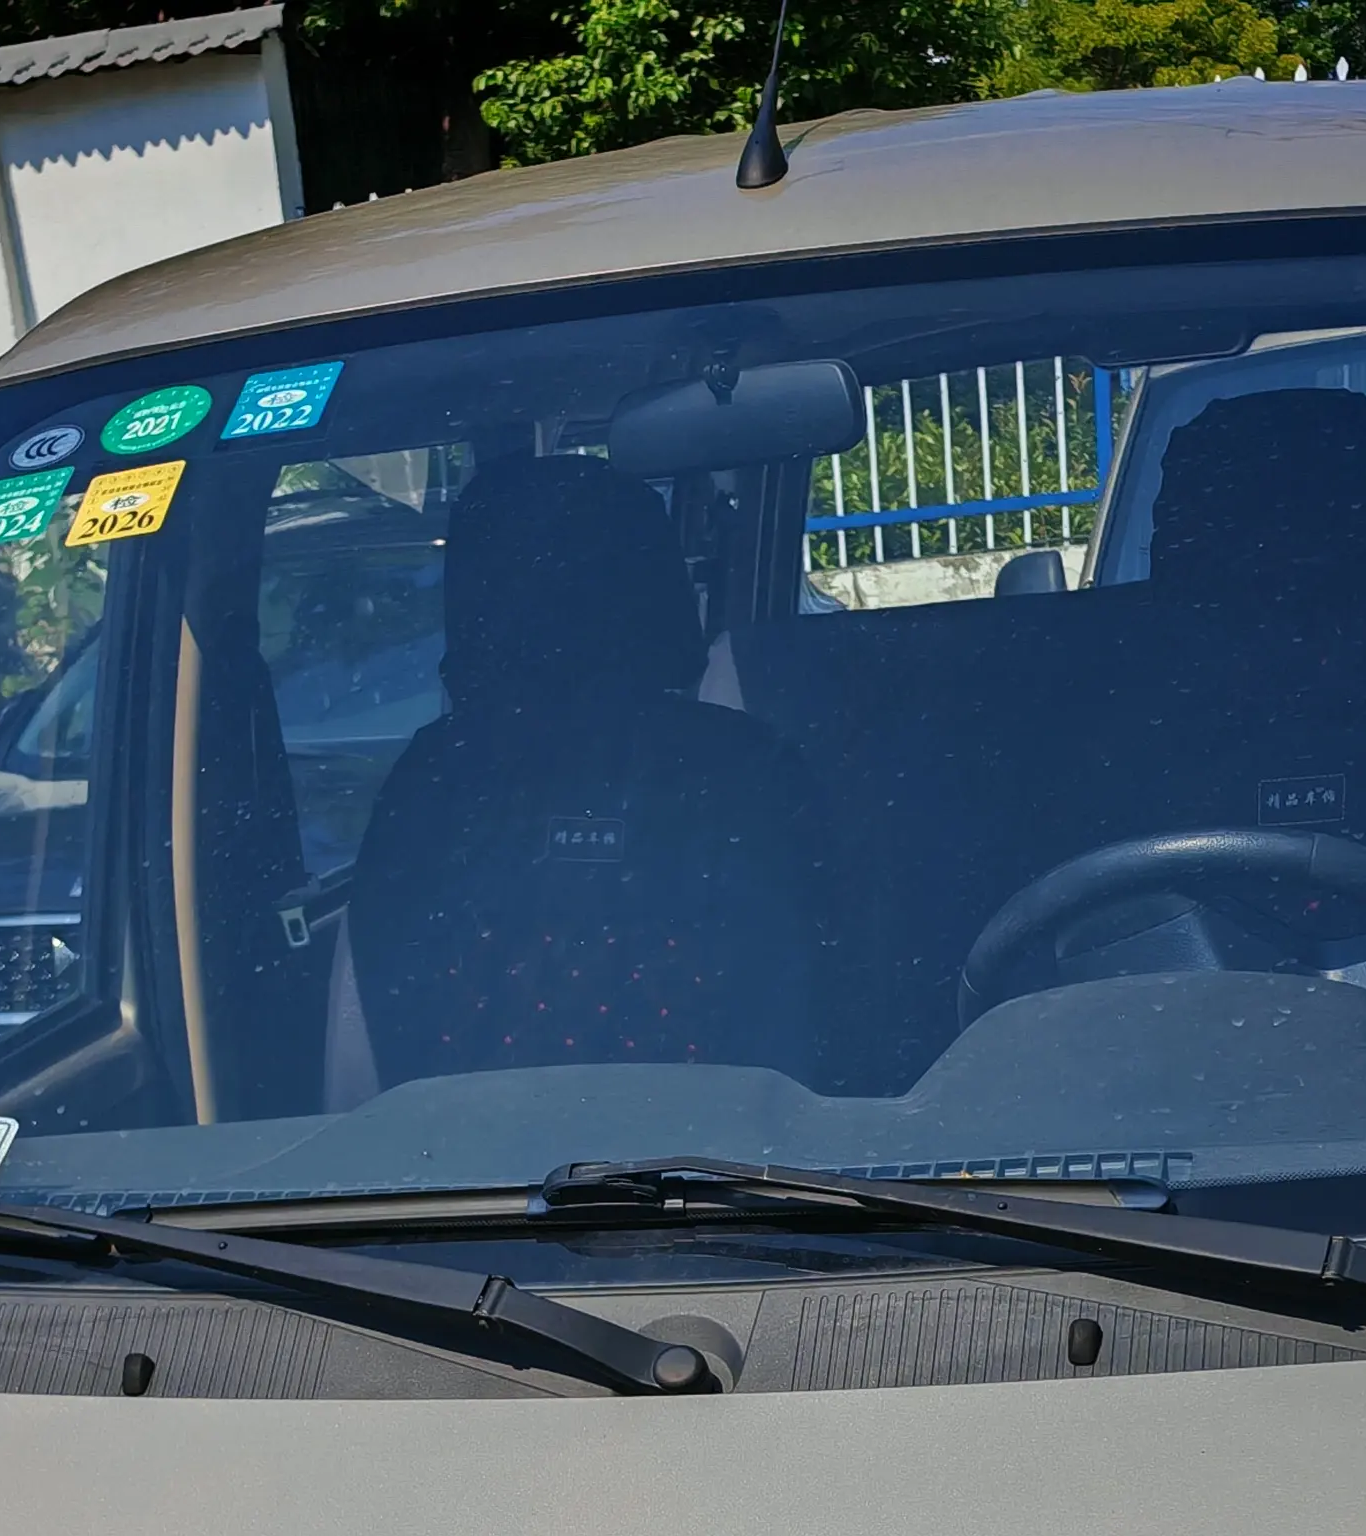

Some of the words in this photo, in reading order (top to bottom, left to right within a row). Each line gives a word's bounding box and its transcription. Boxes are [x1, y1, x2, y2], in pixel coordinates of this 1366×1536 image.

[121, 410, 182, 441] 2021
[230, 404, 313, 435] 2022
[25, 434, 69, 460] CCC
[77, 506, 160, 540] 2026
